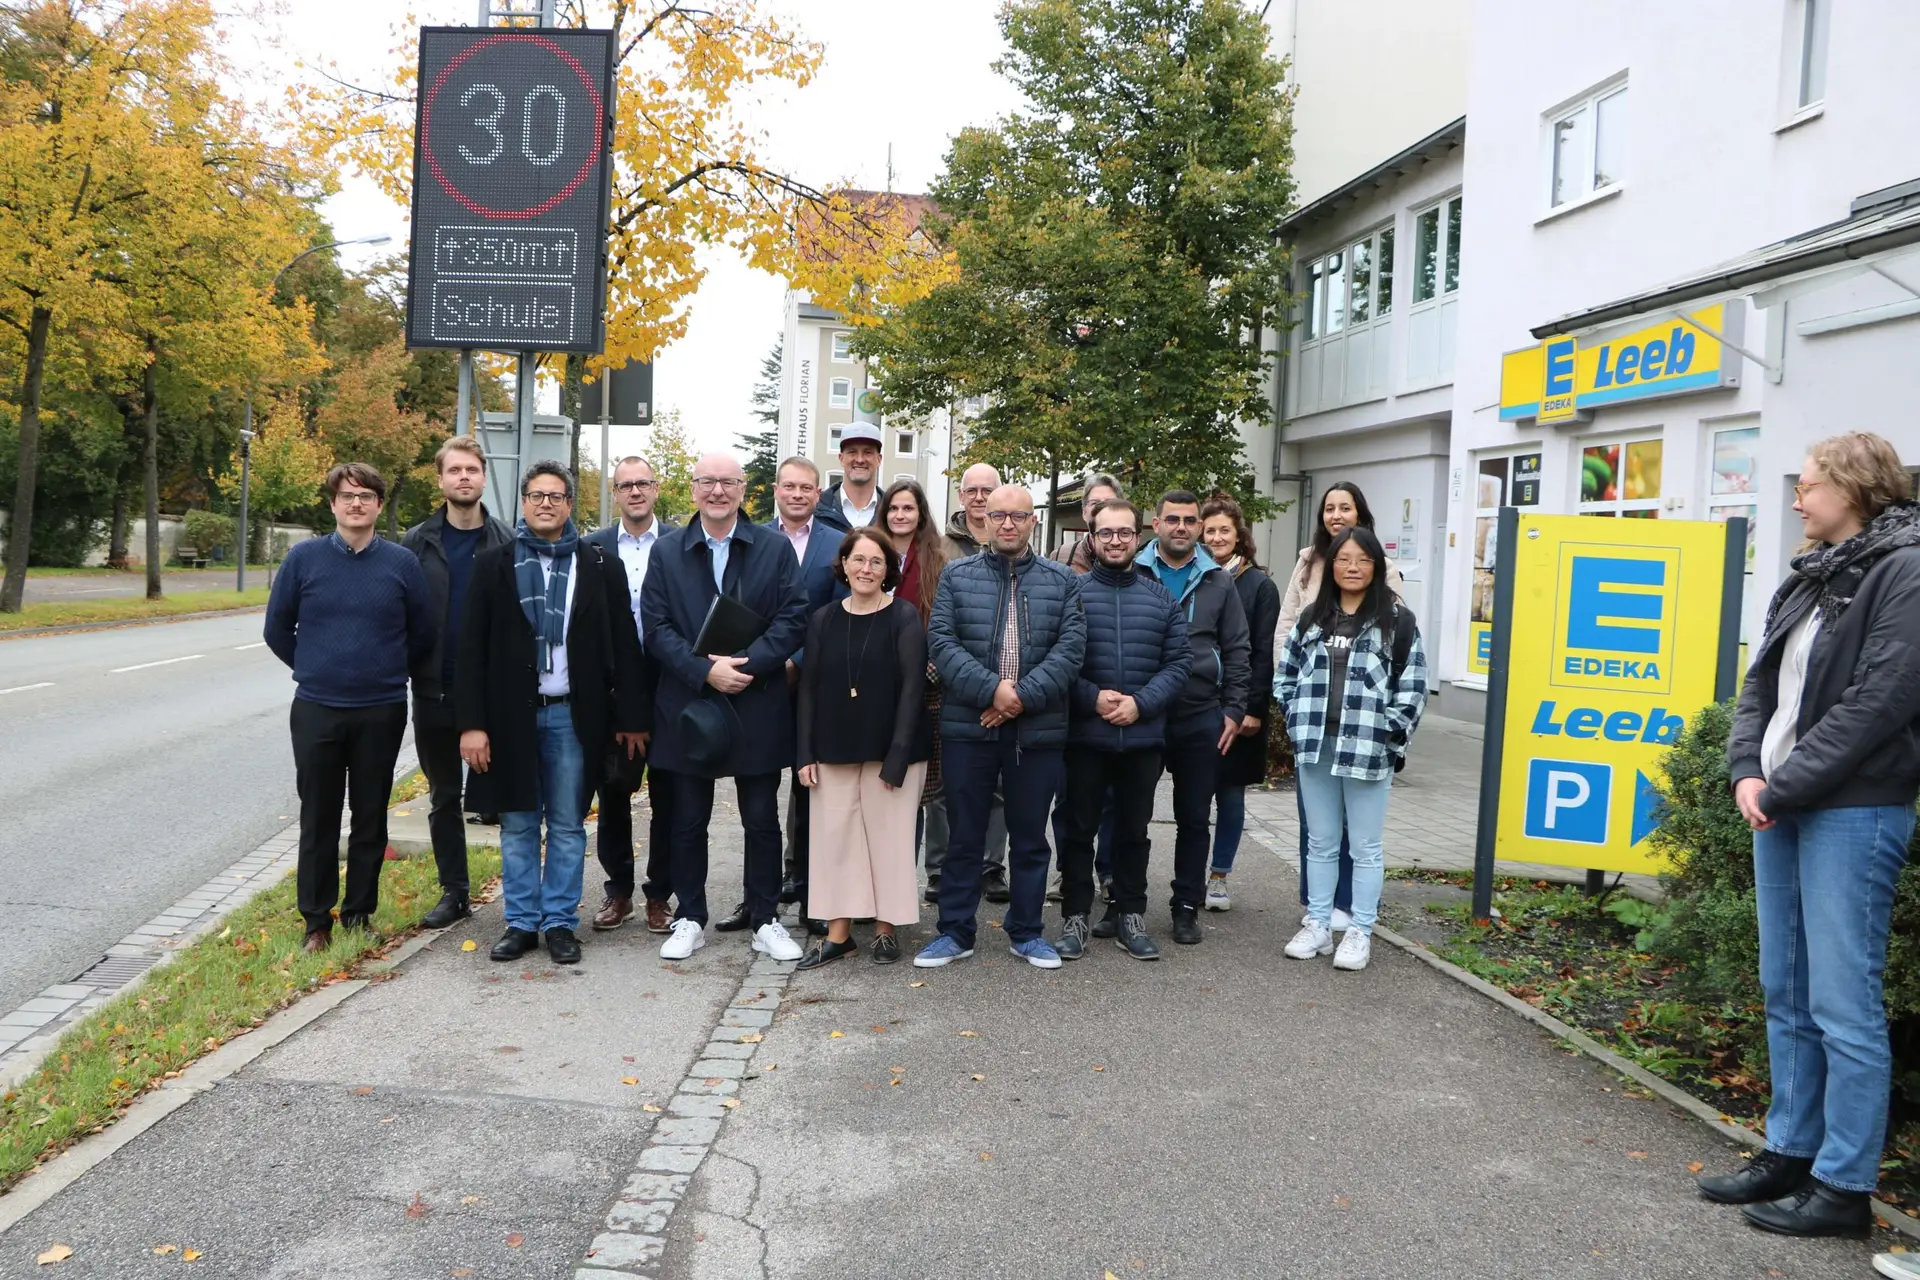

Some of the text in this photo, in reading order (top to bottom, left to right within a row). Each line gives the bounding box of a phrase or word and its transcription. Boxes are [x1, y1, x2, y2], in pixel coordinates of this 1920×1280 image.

[458, 83, 566, 166] 30
[463, 237, 548, 266] 350m
[442, 294, 561, 328] Schule
[1545, 339, 1574, 397] E
[1593, 327, 1696, 389] Leeb
[797, 360, 811, 457] ZTEHAUS FLORIAN
[1543, 397, 1572, 412] EDEKA
[1567, 556, 1666, 654] E
[1564, 656, 1661, 681] EDEKA
[1530, 700, 1685, 746] Leeb
[1544, 770, 1591, 830] P
